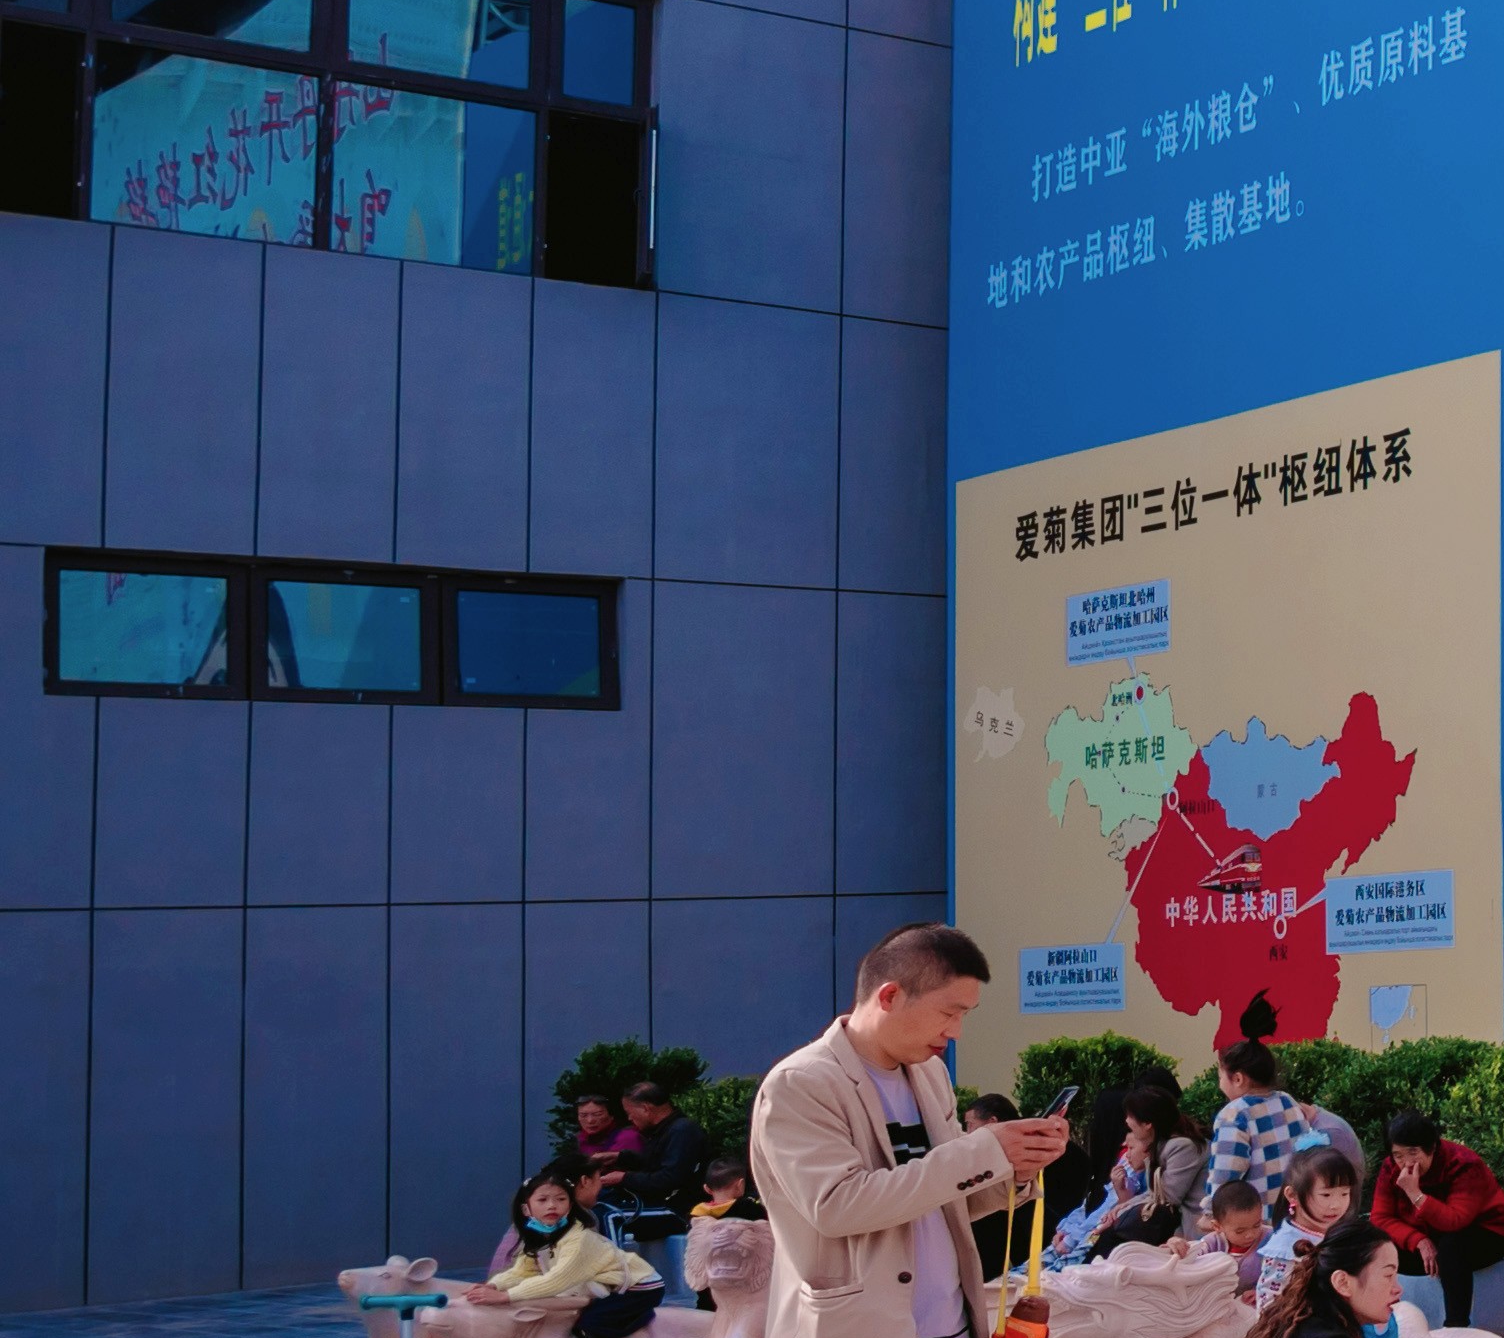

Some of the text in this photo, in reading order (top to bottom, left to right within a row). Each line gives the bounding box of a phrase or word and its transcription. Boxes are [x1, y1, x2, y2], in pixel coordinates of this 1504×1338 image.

[973, 710, 1015, 738] 乌克兰
[1084, 735, 1166, 770] 哈萨克斯坦
[1166, 887, 1297, 928] 中华人民共和国
